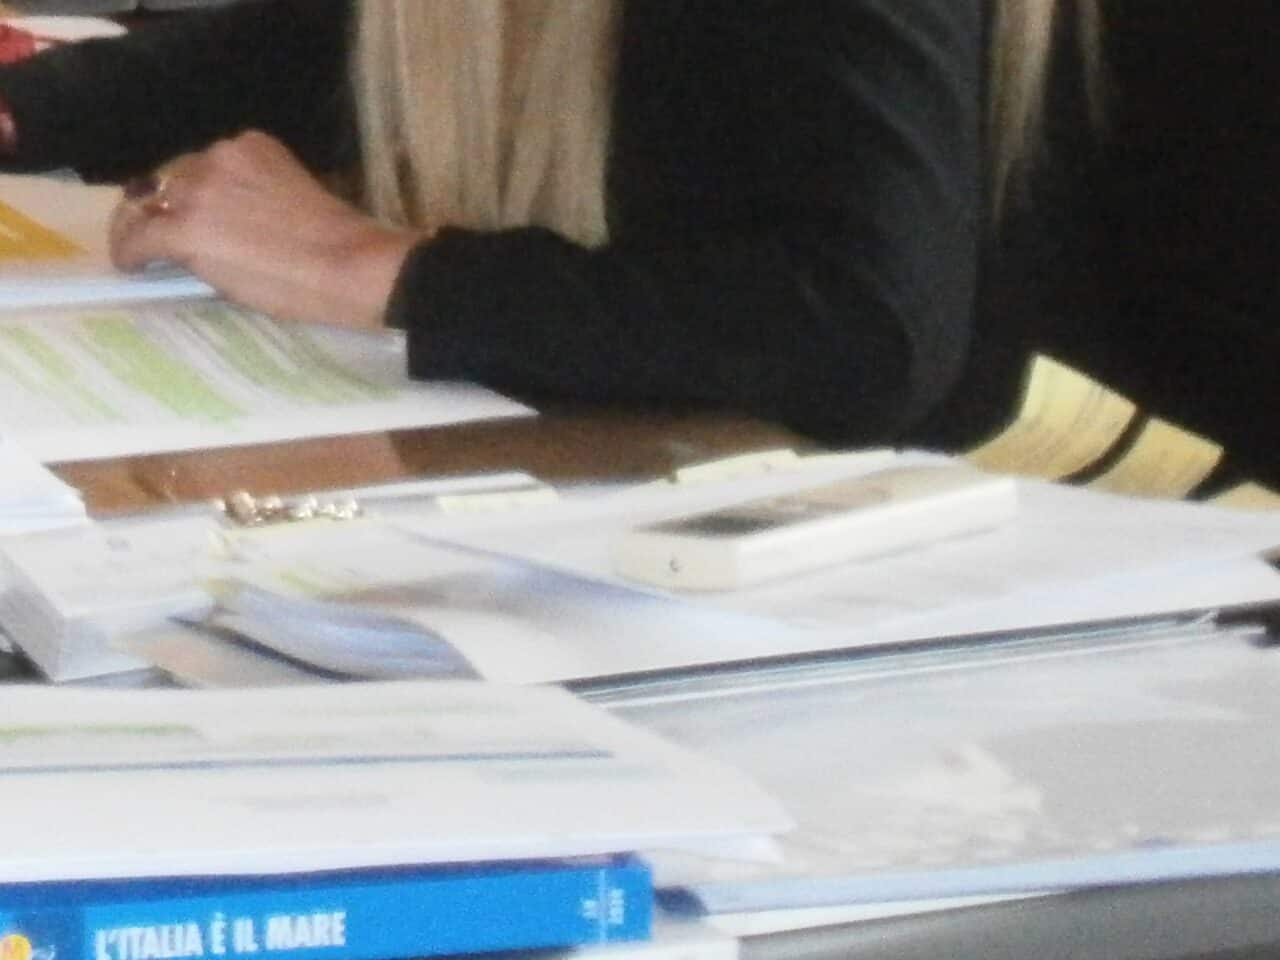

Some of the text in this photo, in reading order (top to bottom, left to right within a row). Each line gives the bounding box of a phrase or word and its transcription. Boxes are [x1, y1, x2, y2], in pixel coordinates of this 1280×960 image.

[95, 911, 346, 960] L'ITALIA È IL MARE
